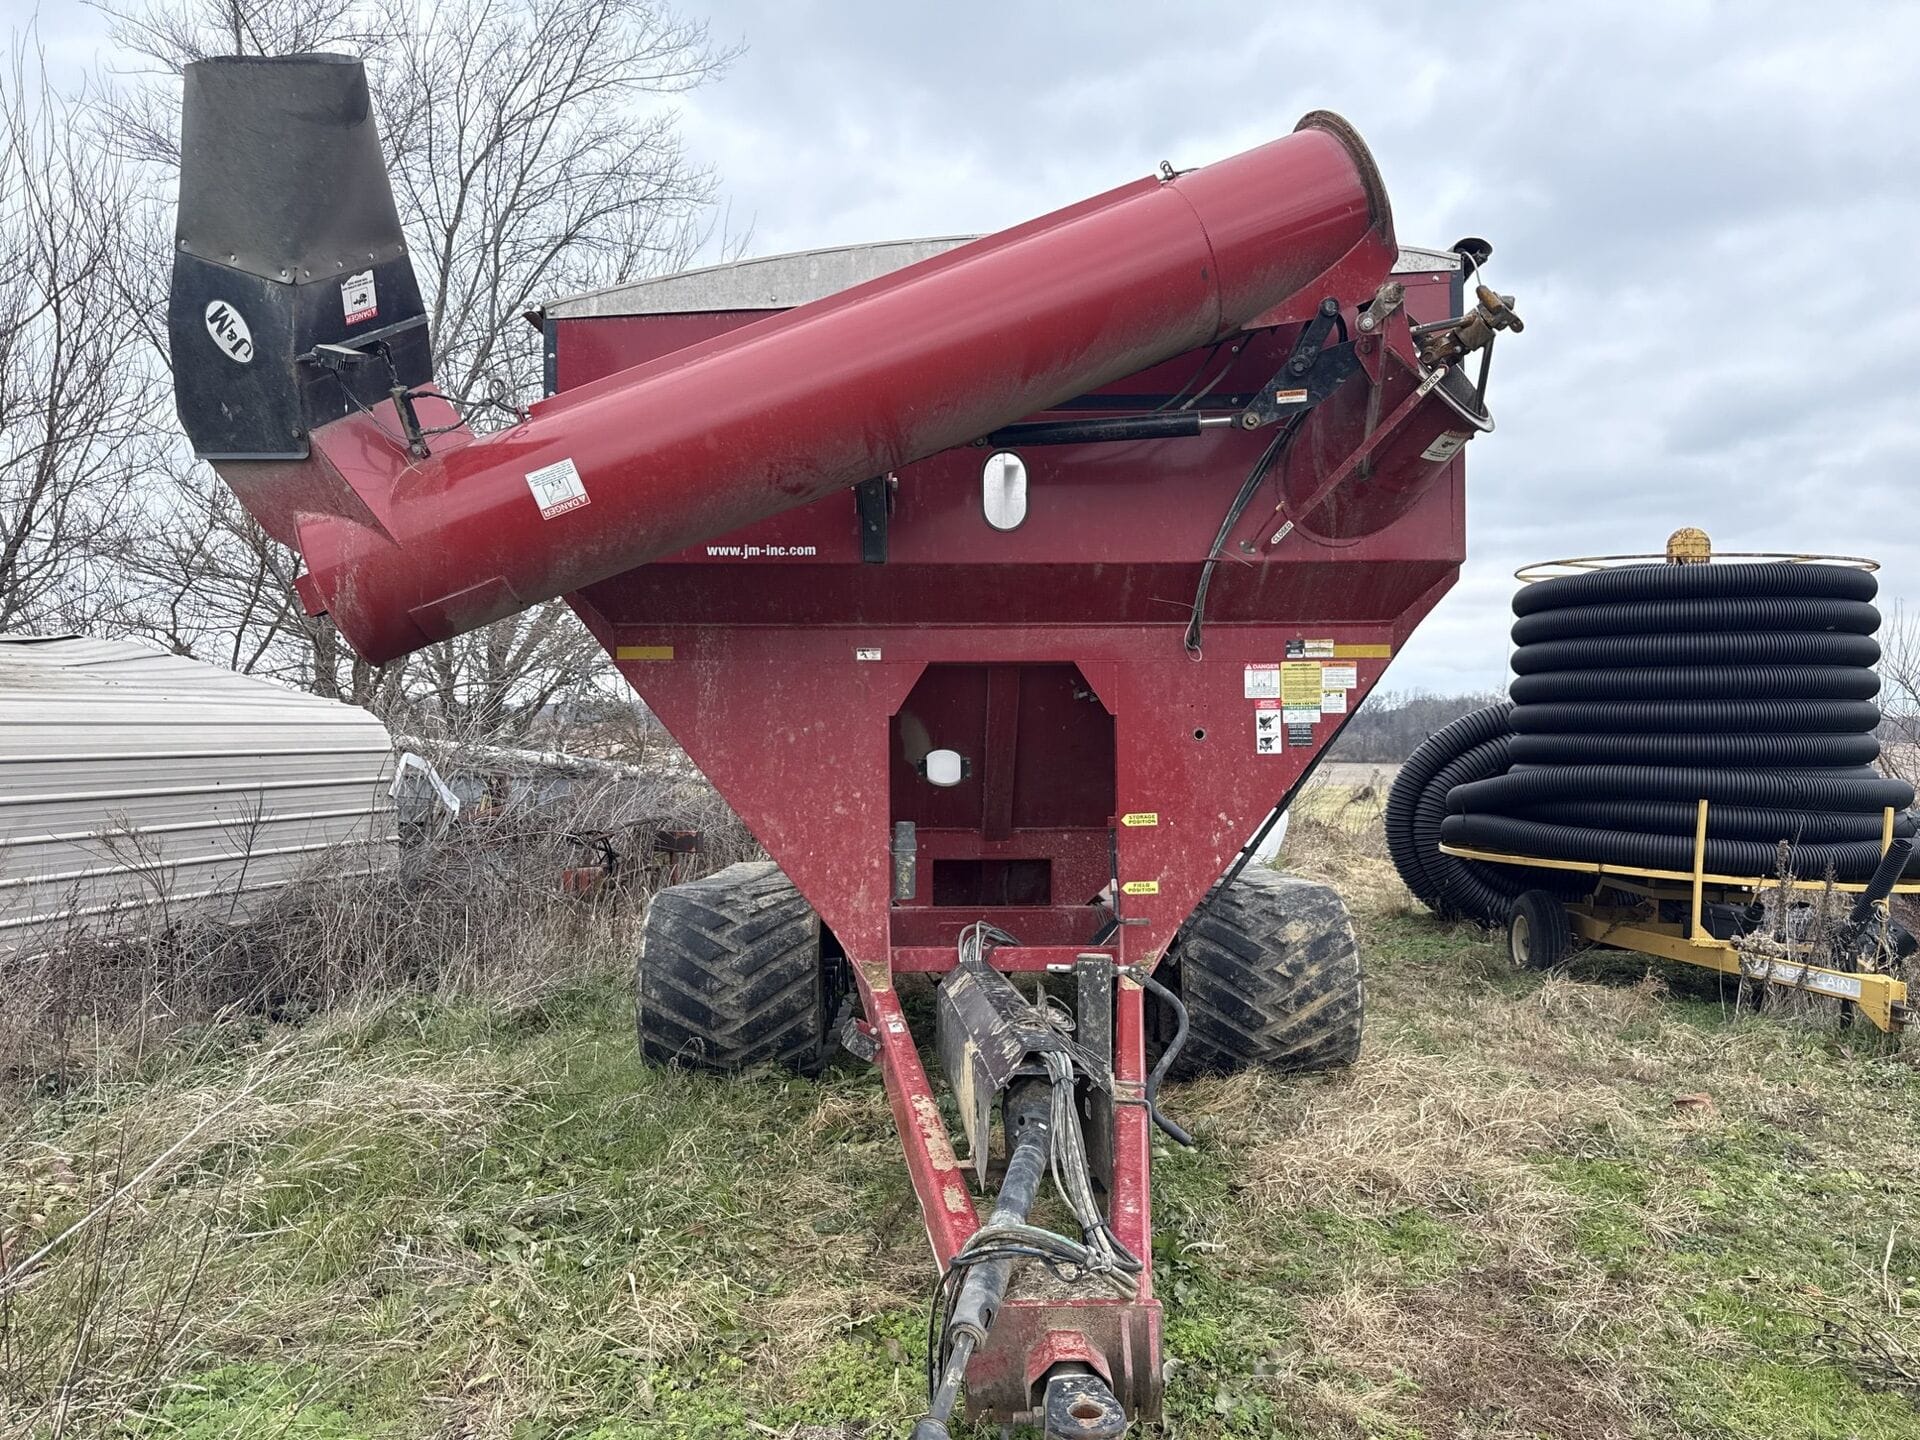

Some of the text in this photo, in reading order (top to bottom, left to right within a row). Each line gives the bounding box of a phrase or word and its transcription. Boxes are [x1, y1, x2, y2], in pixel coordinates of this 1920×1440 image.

[346, 308, 372, 325] DANGER
[207, 303, 252, 358] J&M
[1422, 373, 1440, 392] OPEN
[543, 498, 580, 518] DANGER
[706, 543, 817, 560] www.jm-inc.com
